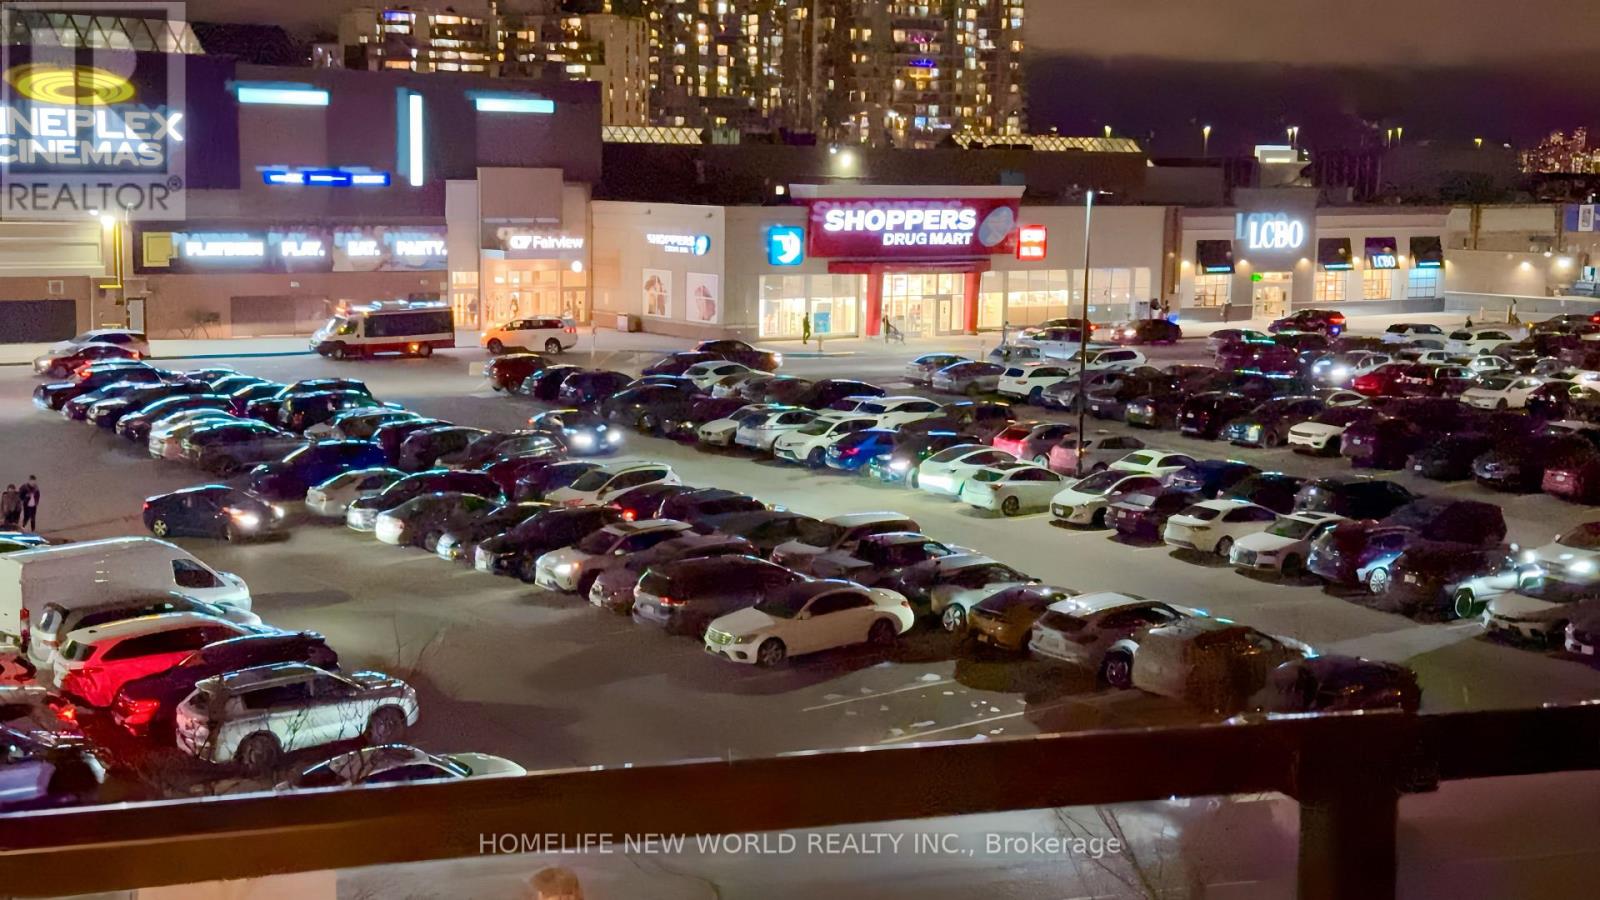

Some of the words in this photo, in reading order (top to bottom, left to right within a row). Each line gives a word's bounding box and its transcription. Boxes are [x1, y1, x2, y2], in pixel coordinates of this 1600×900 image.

[0, 138, 165, 167] CINEMAS
[824, 208, 977, 232] SHOPPERS
[533, 235, 584, 249] Fairview
[883, 232, 927, 245] DRUG
[929, 232, 973, 245] MART
[1249, 220, 1304, 249] LCBO
[1372, 255, 1396, 269] LCBO
